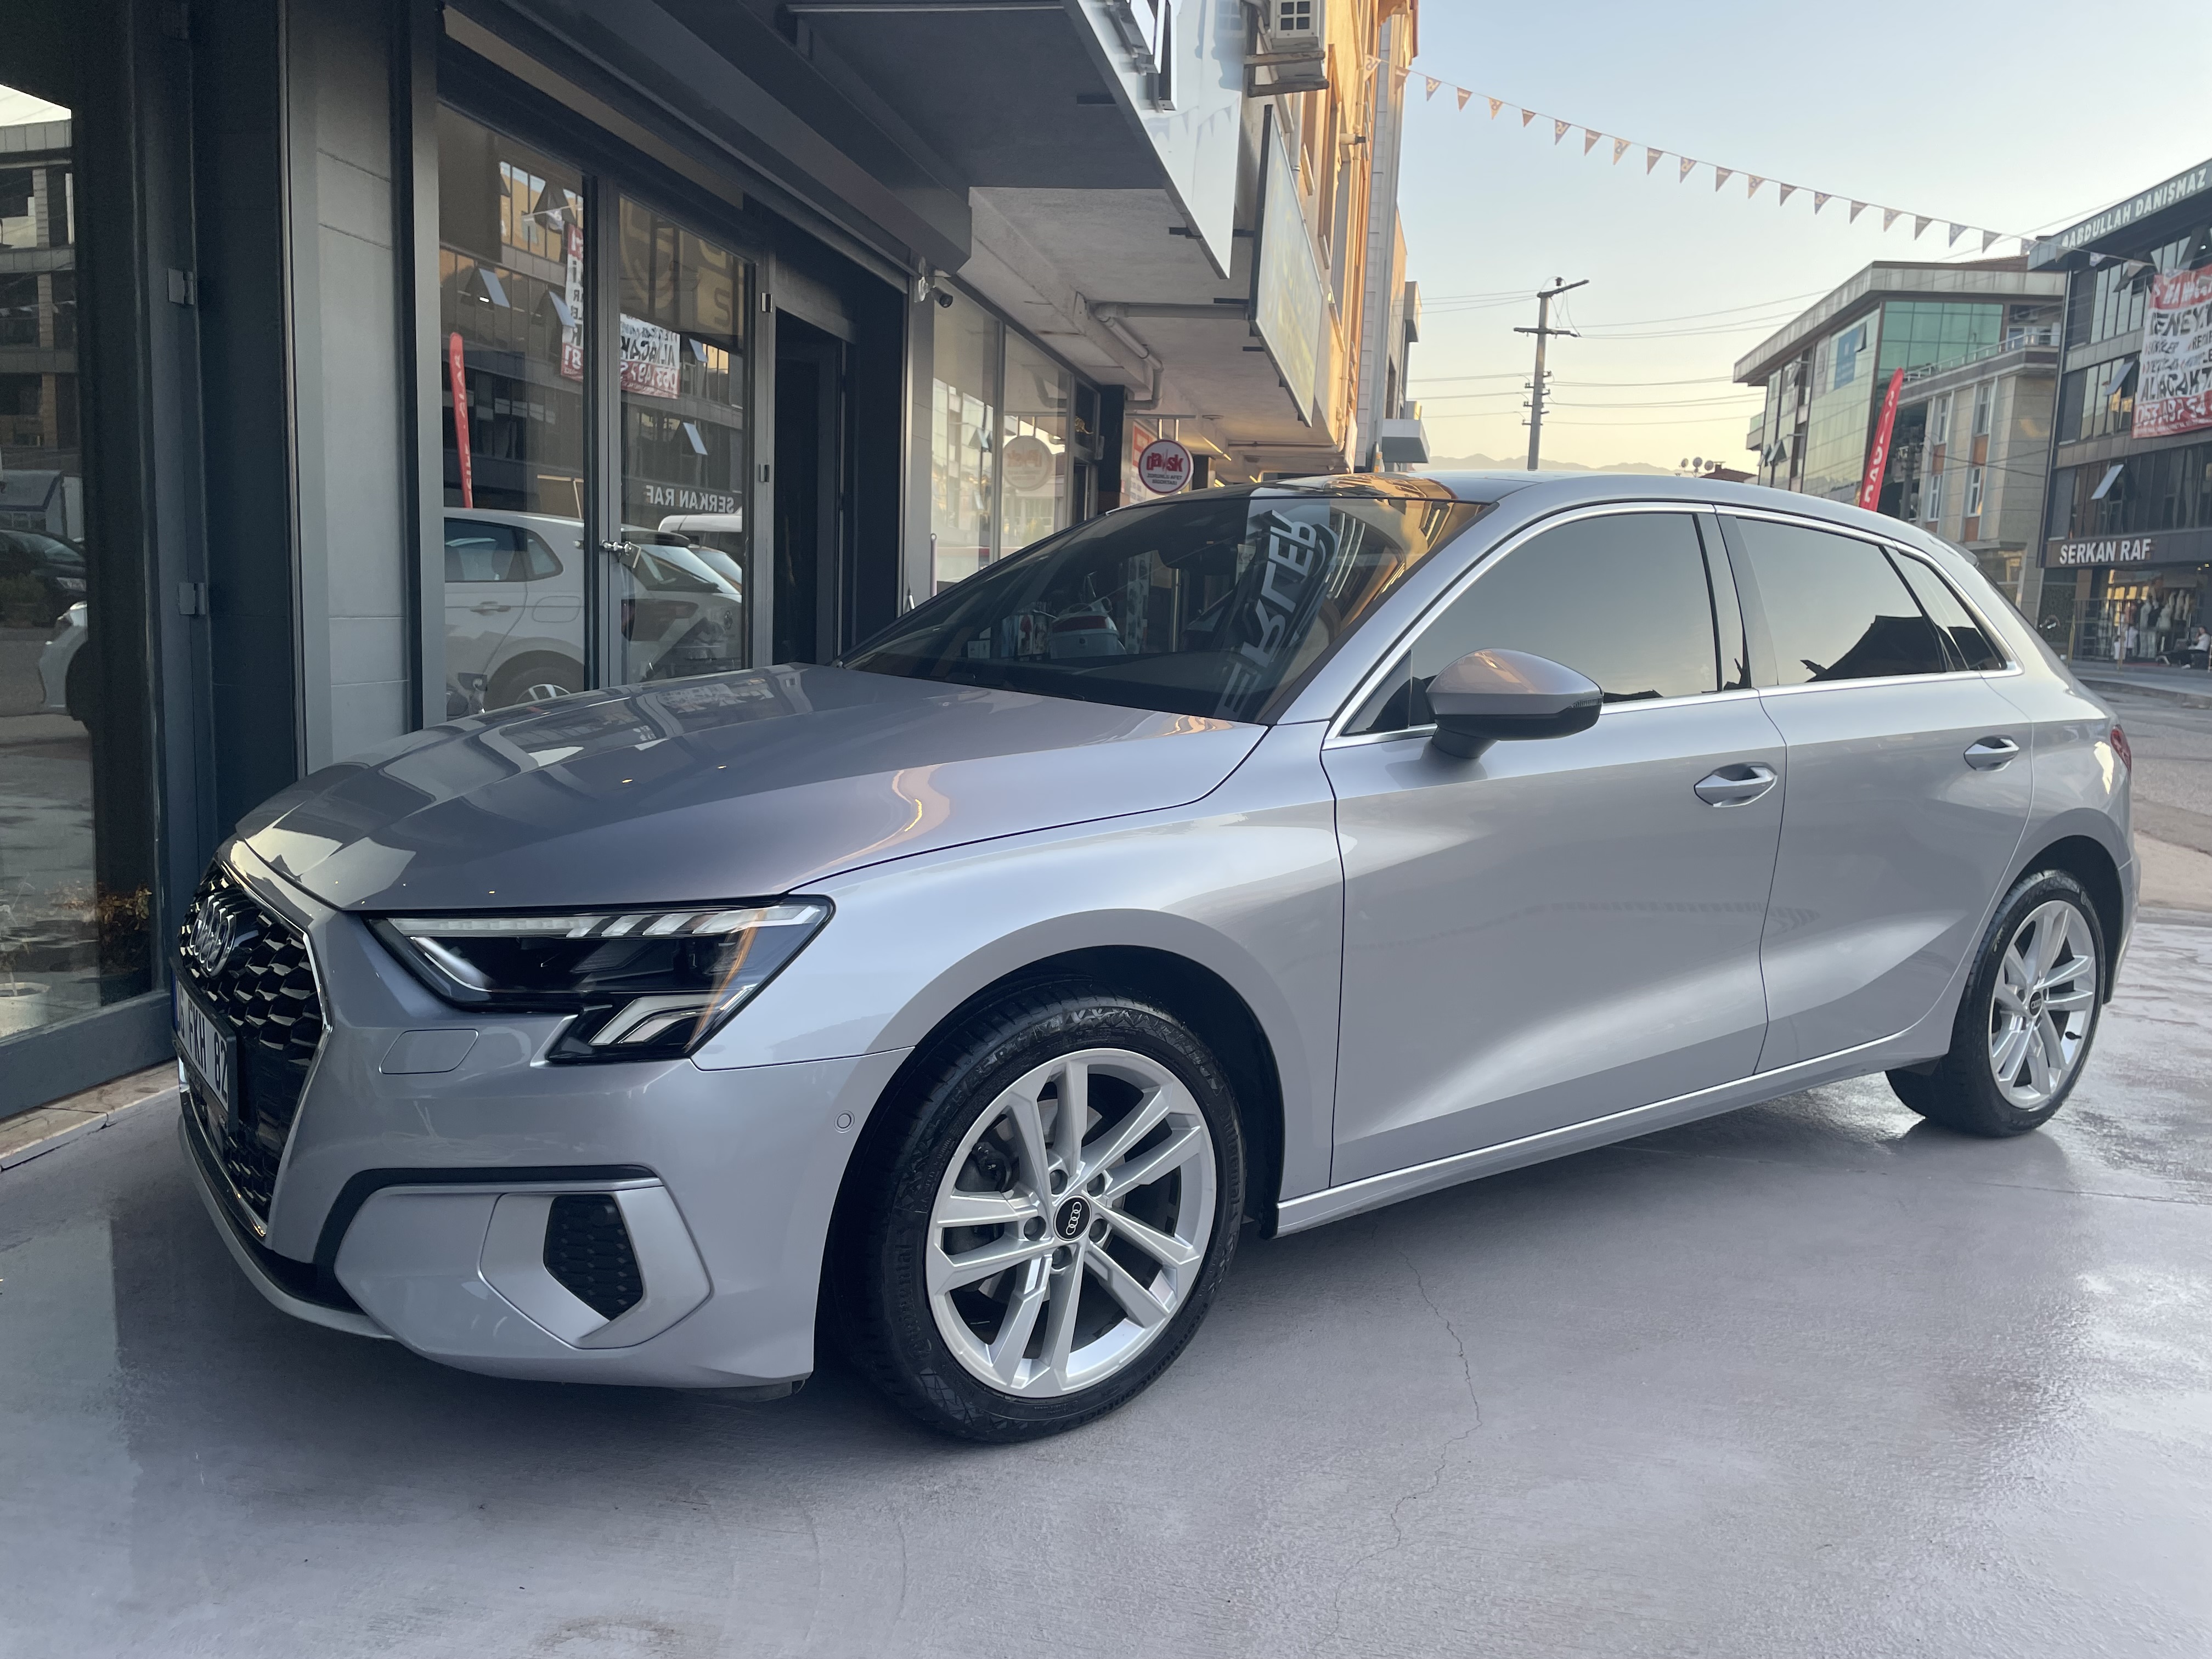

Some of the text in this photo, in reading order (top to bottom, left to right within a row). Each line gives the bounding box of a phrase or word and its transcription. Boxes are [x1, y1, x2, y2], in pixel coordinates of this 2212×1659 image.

[2135, 167, 2207, 217] DANIŞMAZ
[2059, 538, 2152, 565] SERKAN RAF
[188, 998, 207, 1074] FKH
[214, 1031, 228, 1104] 82
